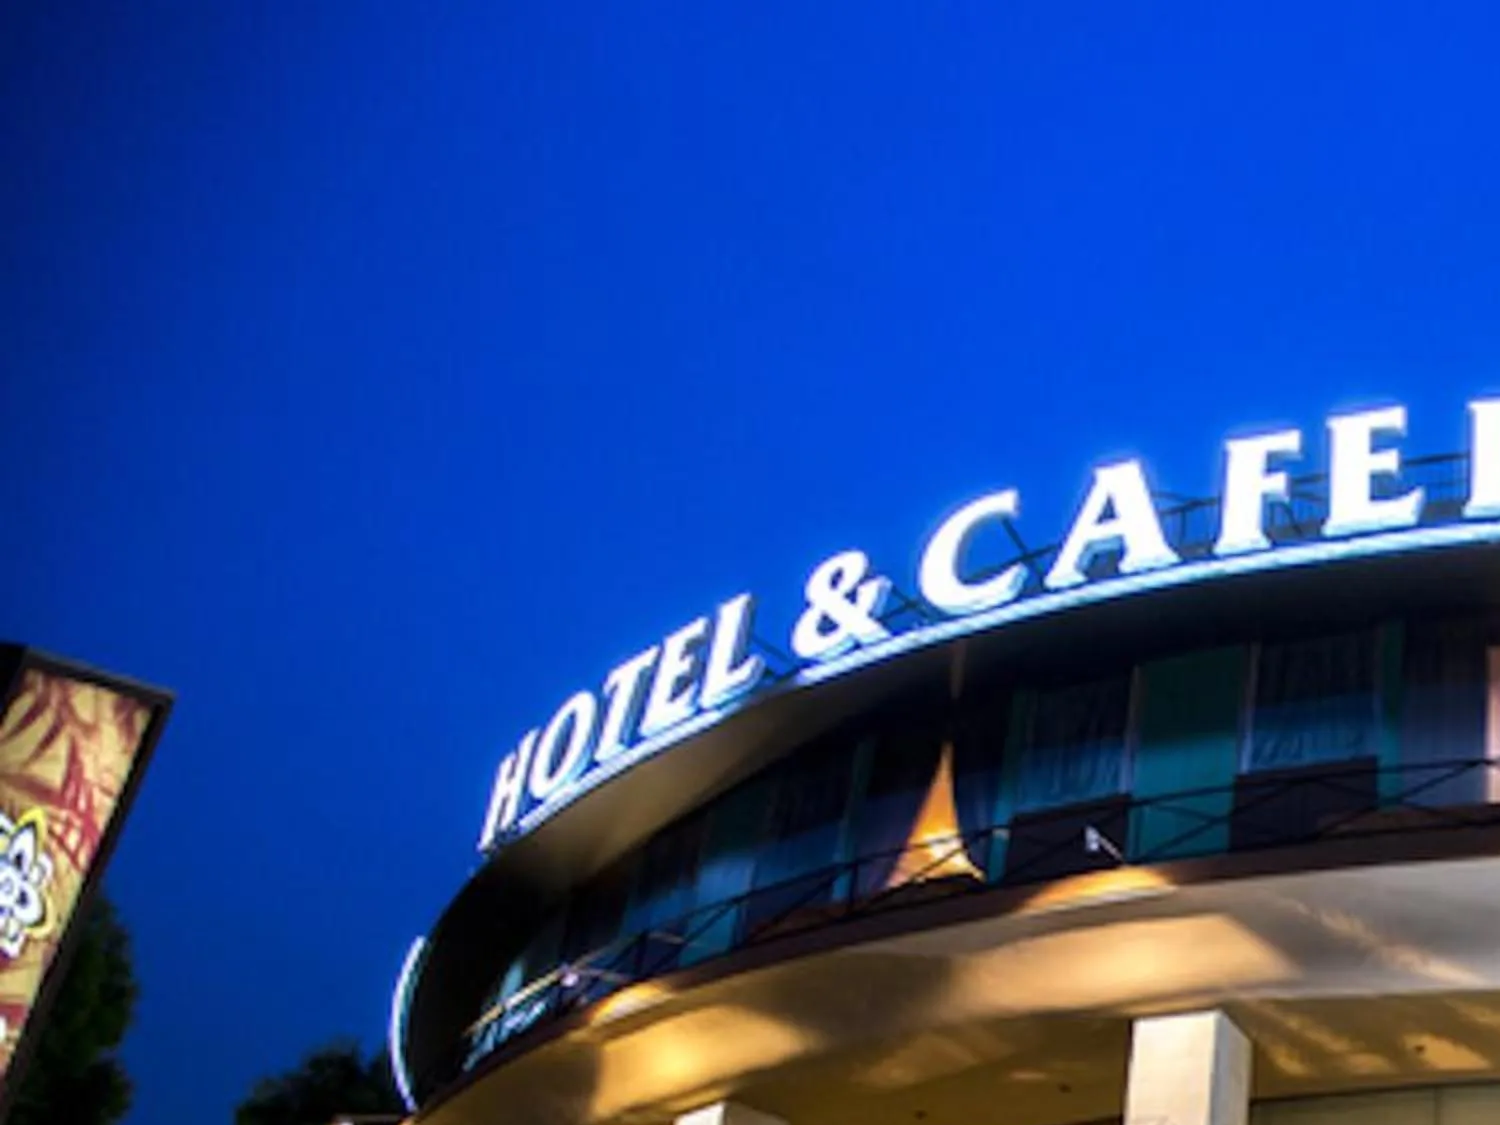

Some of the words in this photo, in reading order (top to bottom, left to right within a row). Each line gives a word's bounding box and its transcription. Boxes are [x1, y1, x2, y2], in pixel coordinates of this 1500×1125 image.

[478, 592, 764, 855] HOTEL
[792, 549, 892, 662] &
[919, 405, 1425, 615] CAFE
